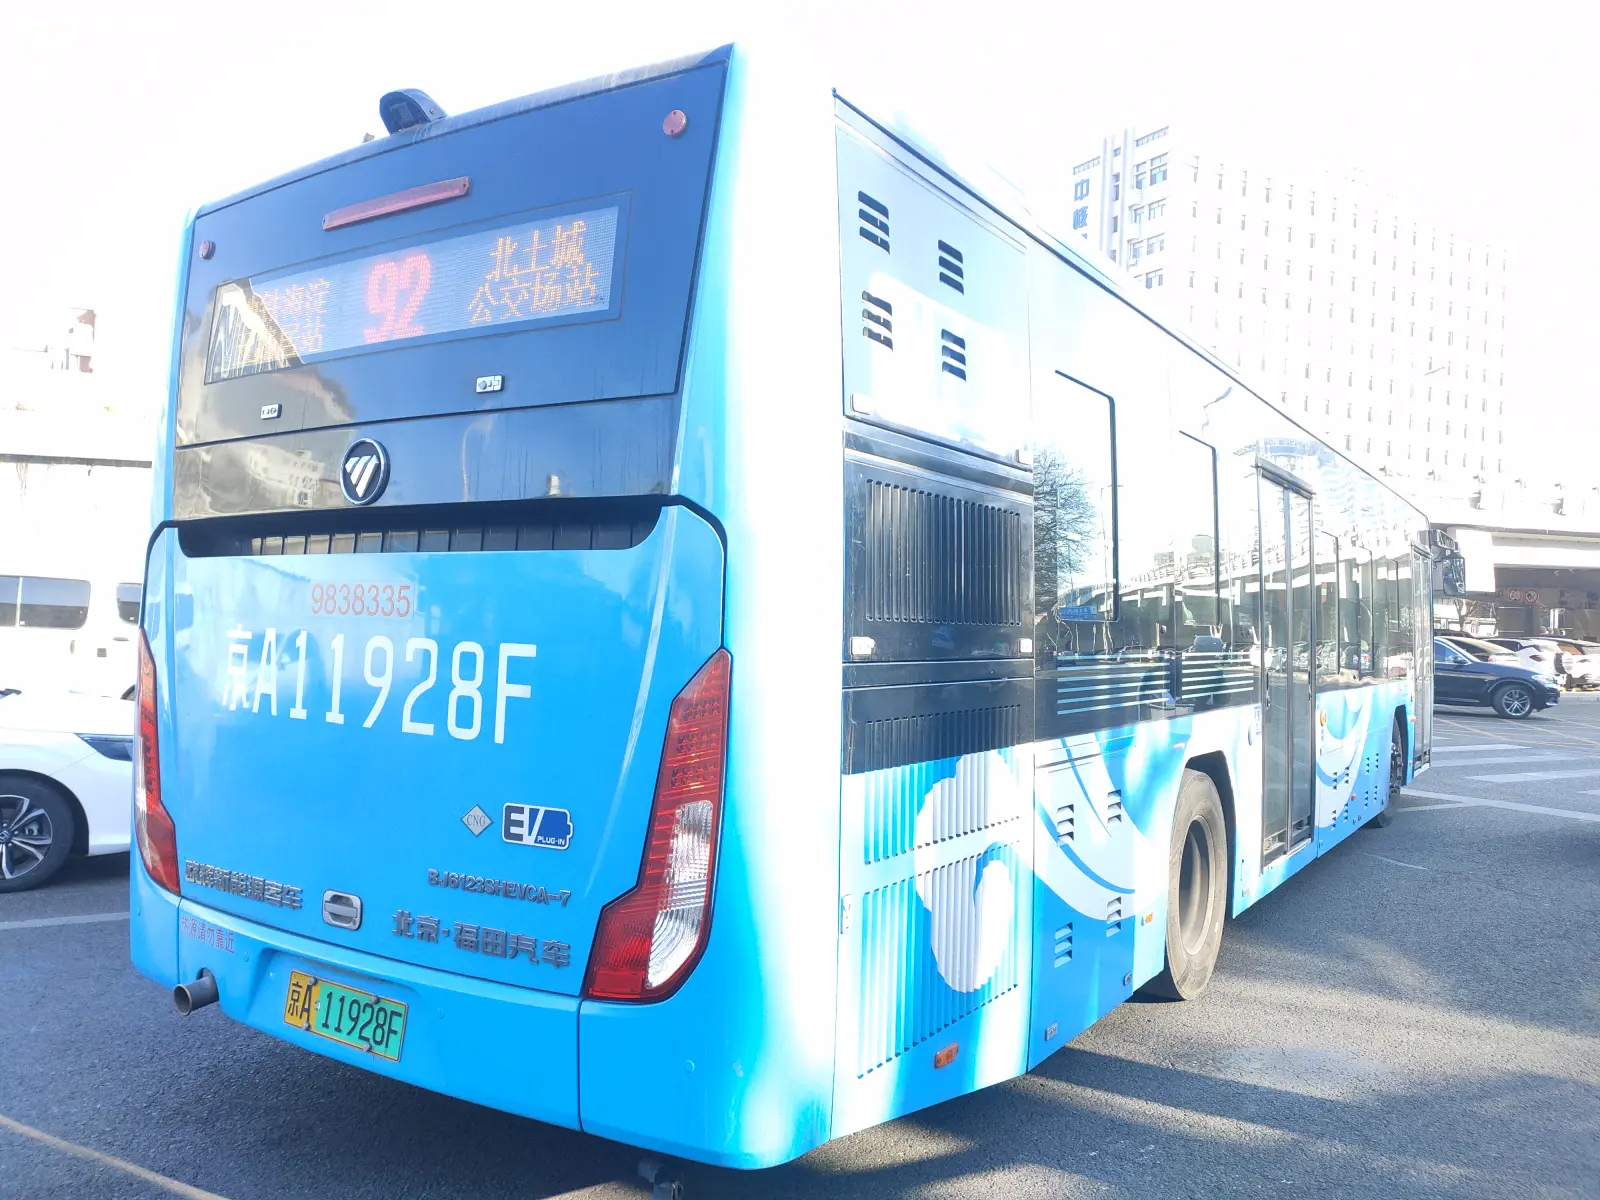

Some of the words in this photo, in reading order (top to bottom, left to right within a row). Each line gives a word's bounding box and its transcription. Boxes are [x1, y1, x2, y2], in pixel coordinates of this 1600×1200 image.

[489, 219, 587, 282] 北土城
[364, 253, 431, 343] 92
[468, 262, 601, 325] 公交场站
[310, 582, 411, 618] 9838335
[220, 622, 538, 745] 京A11928F
[466, 814, 487, 827] CNG
[503, 804, 546, 843] EV
[536, 835, 566, 847] PLUG-IN
[428, 868, 572, 909] BJ6123SHEVCA-7
[287, 981, 403, 1050] 京A11928F
